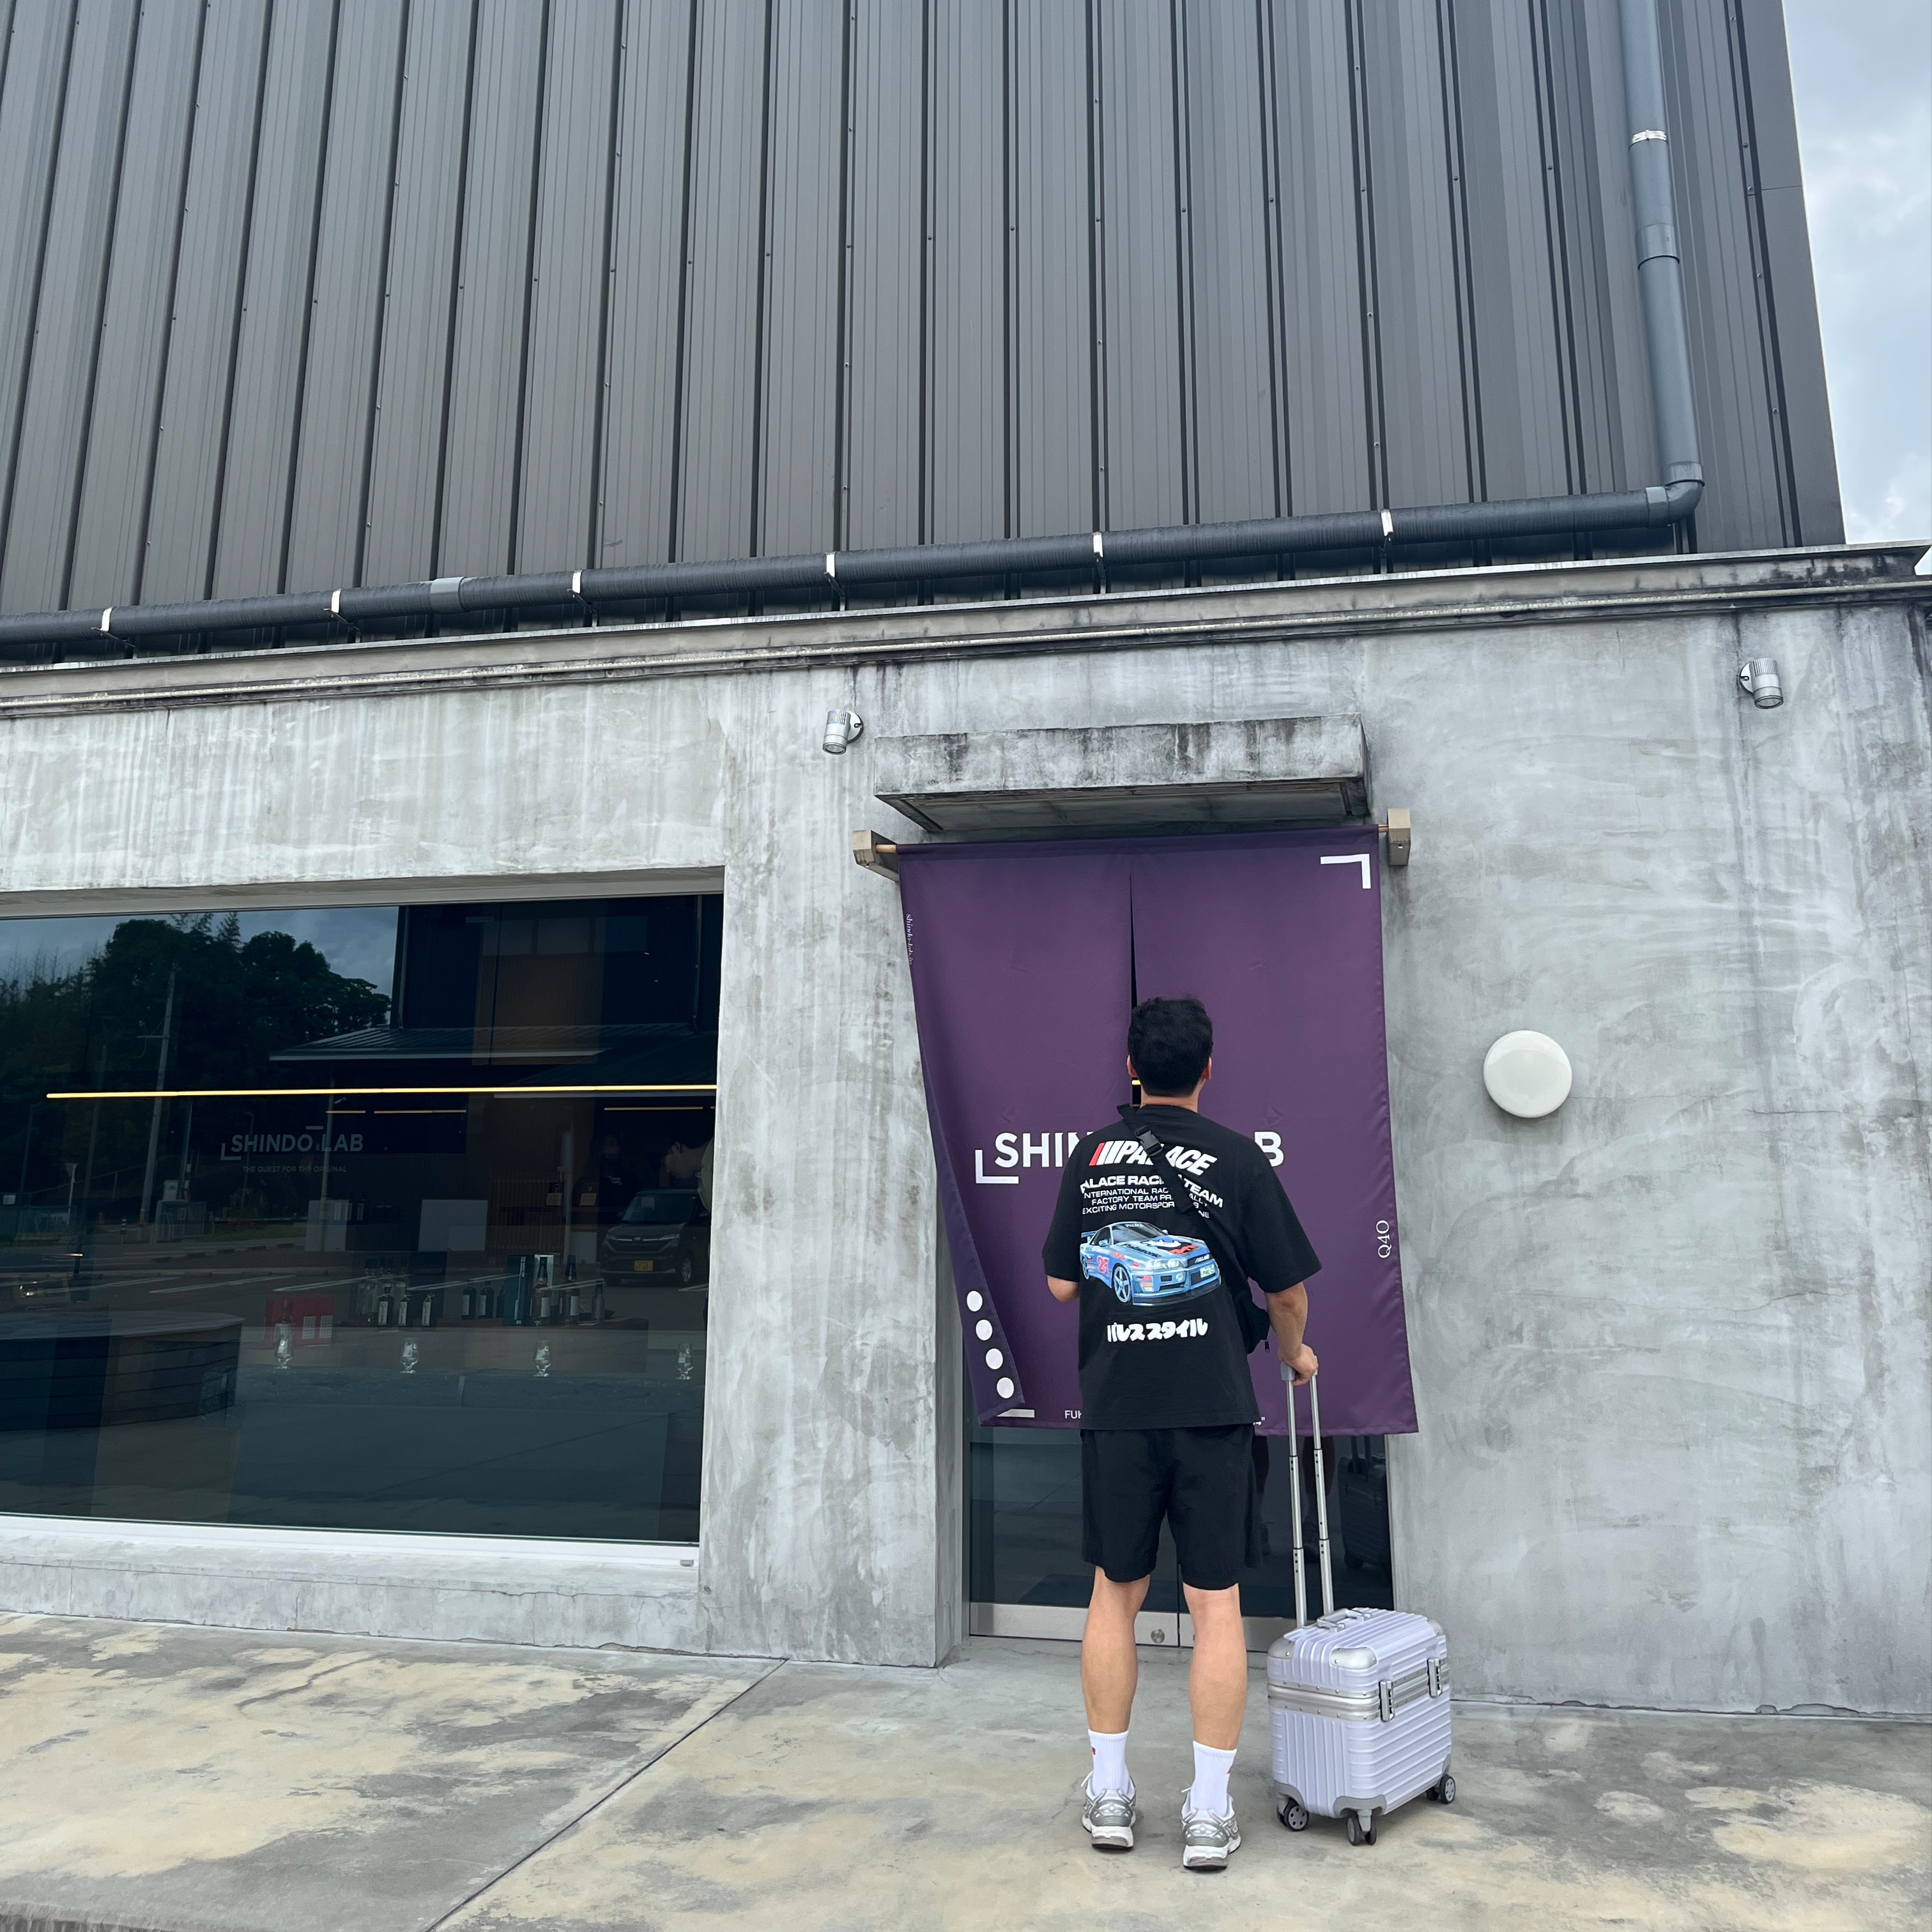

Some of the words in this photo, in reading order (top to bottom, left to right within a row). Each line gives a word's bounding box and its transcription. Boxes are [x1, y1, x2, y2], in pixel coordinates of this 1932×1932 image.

[231, 1134, 313, 1153] SHINDO
[321, 1133, 364, 1152] LAB
[1110, 1140, 1218, 1176] PAACE
[1091, 1195, 1130, 1206] FACTORY
[1183, 1177, 1223, 1208] TEAM
[1082, 1205, 1117, 1215] EXCITING
[1118, 1201, 1176, 1210] MOTORSPOR
